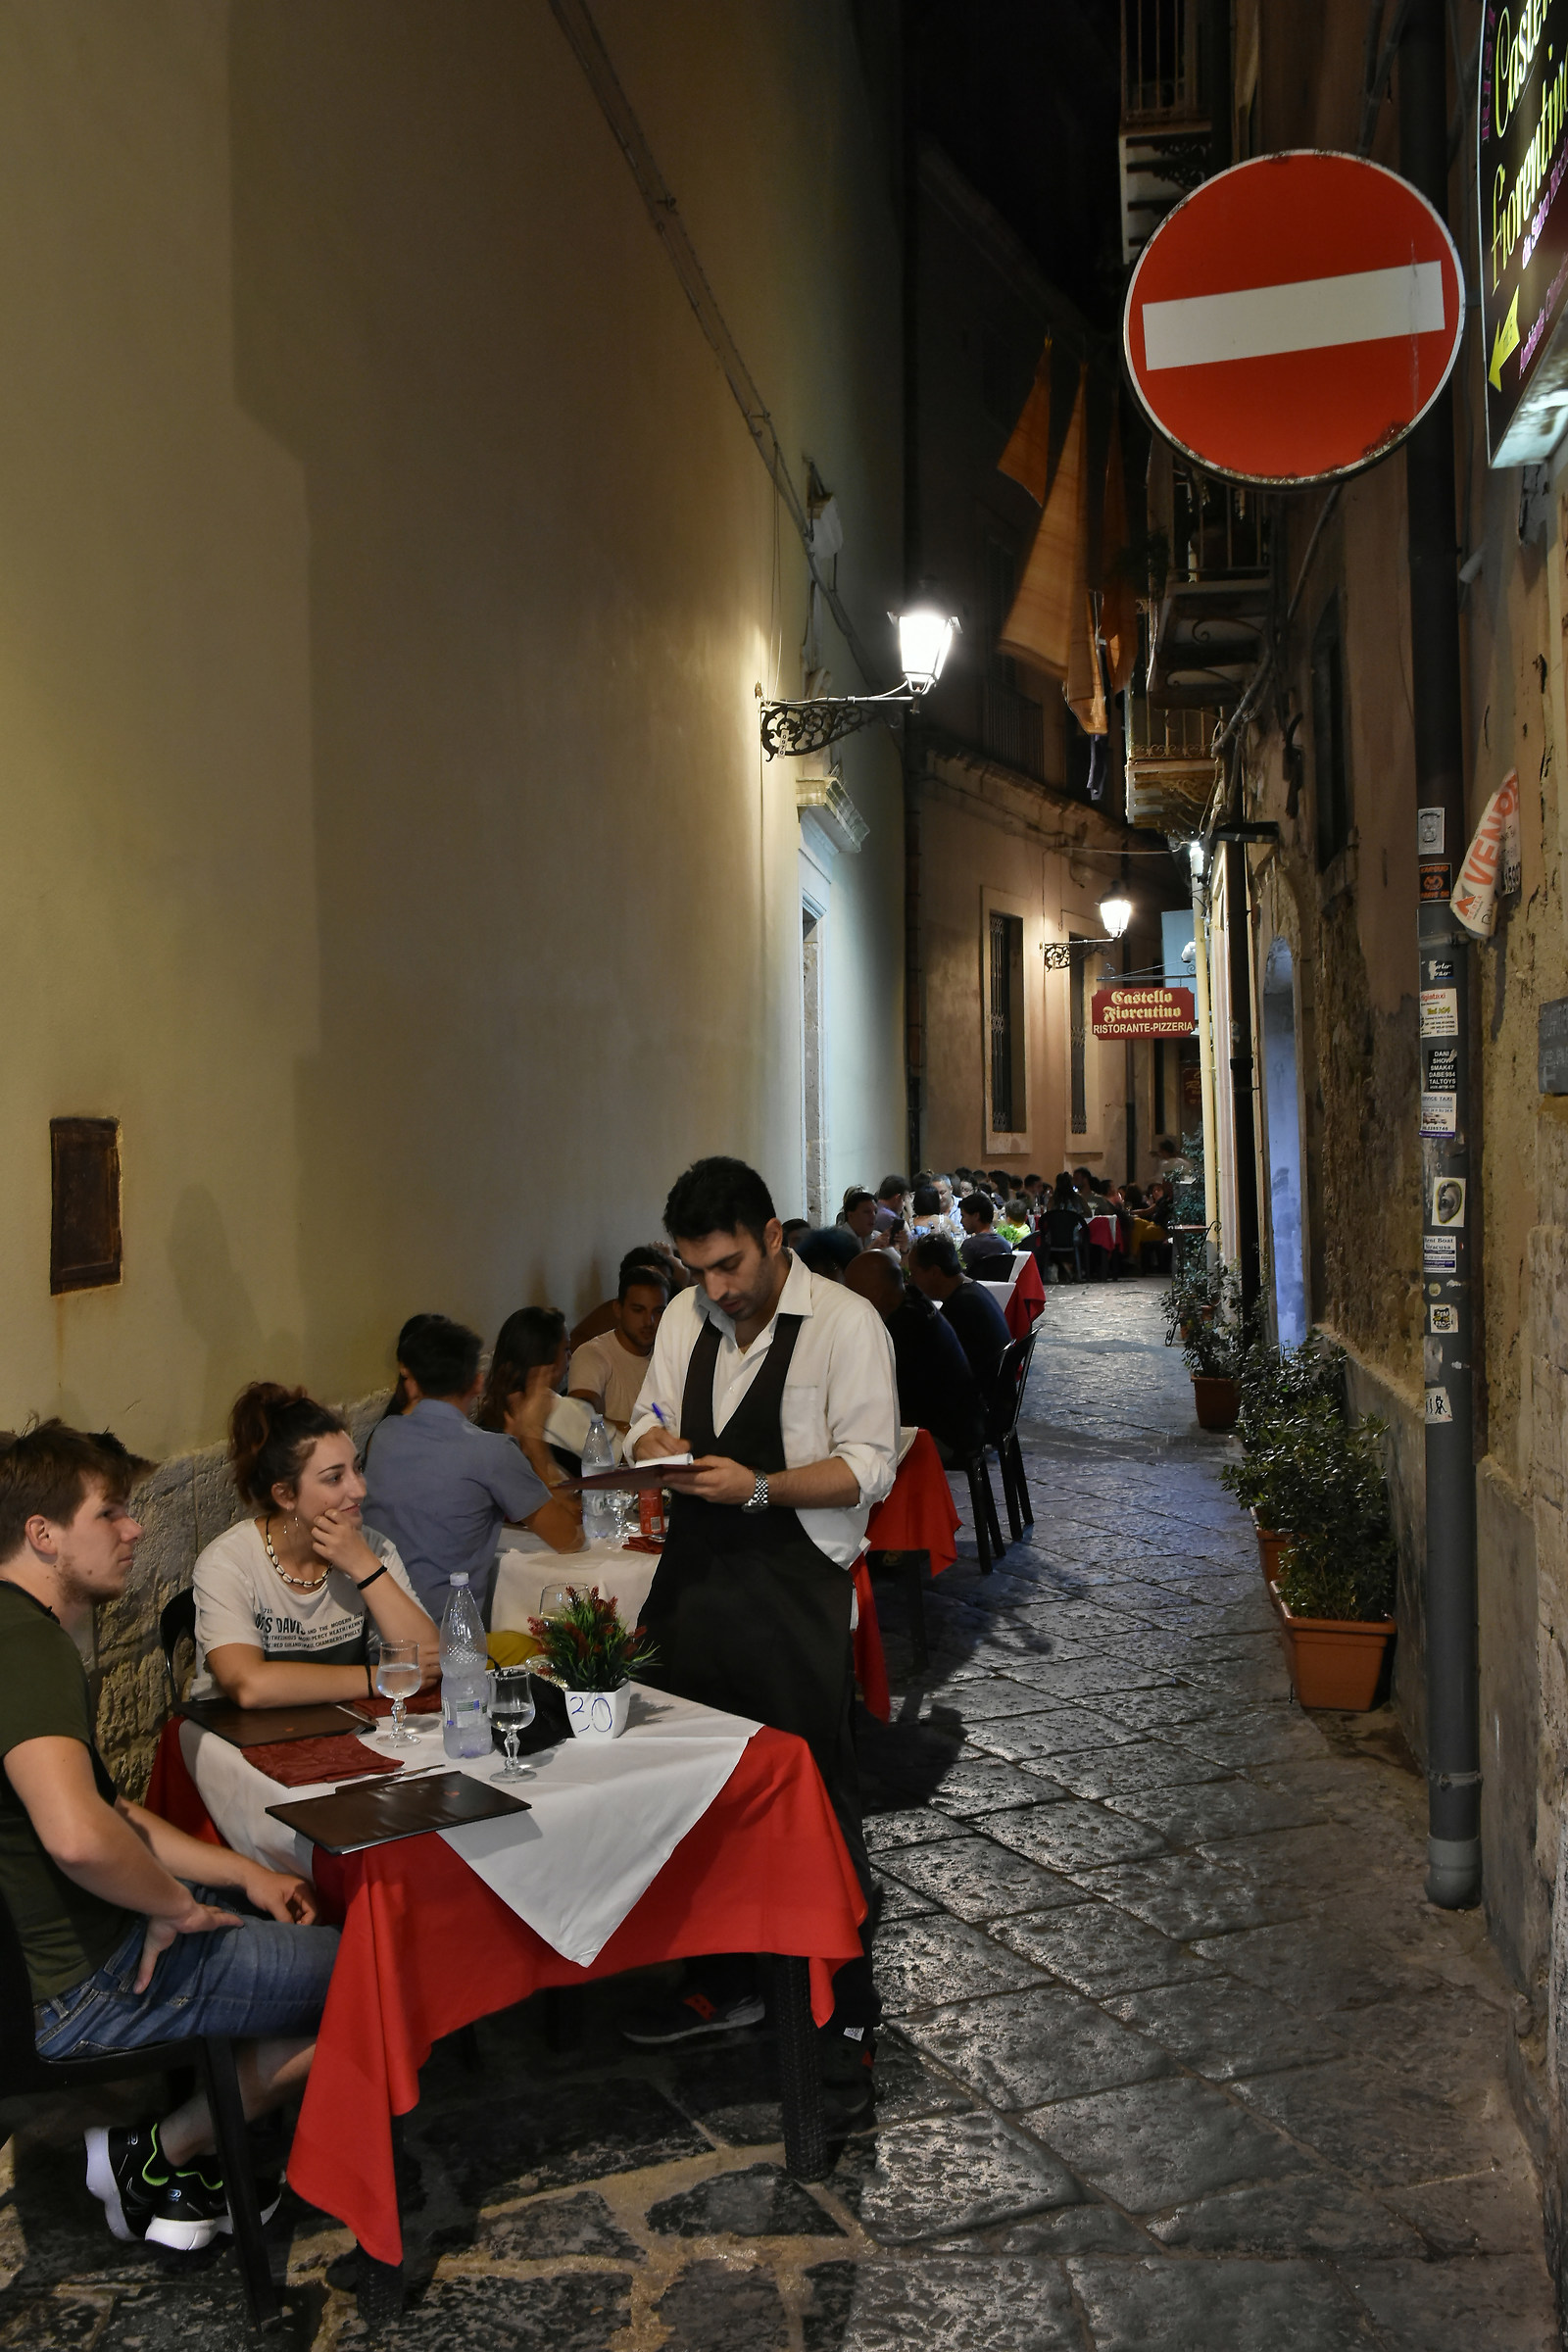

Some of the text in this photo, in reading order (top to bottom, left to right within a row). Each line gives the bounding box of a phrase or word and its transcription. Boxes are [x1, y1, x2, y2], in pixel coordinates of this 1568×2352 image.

[1110, 990, 1173, 1005] Castello
[1102, 1004, 1182, 1024] Fiorentino
[1093, 1021, 1194, 1034] RISTORANTE-PIZZERIA
[569, 1696, 612, 1733] 20
